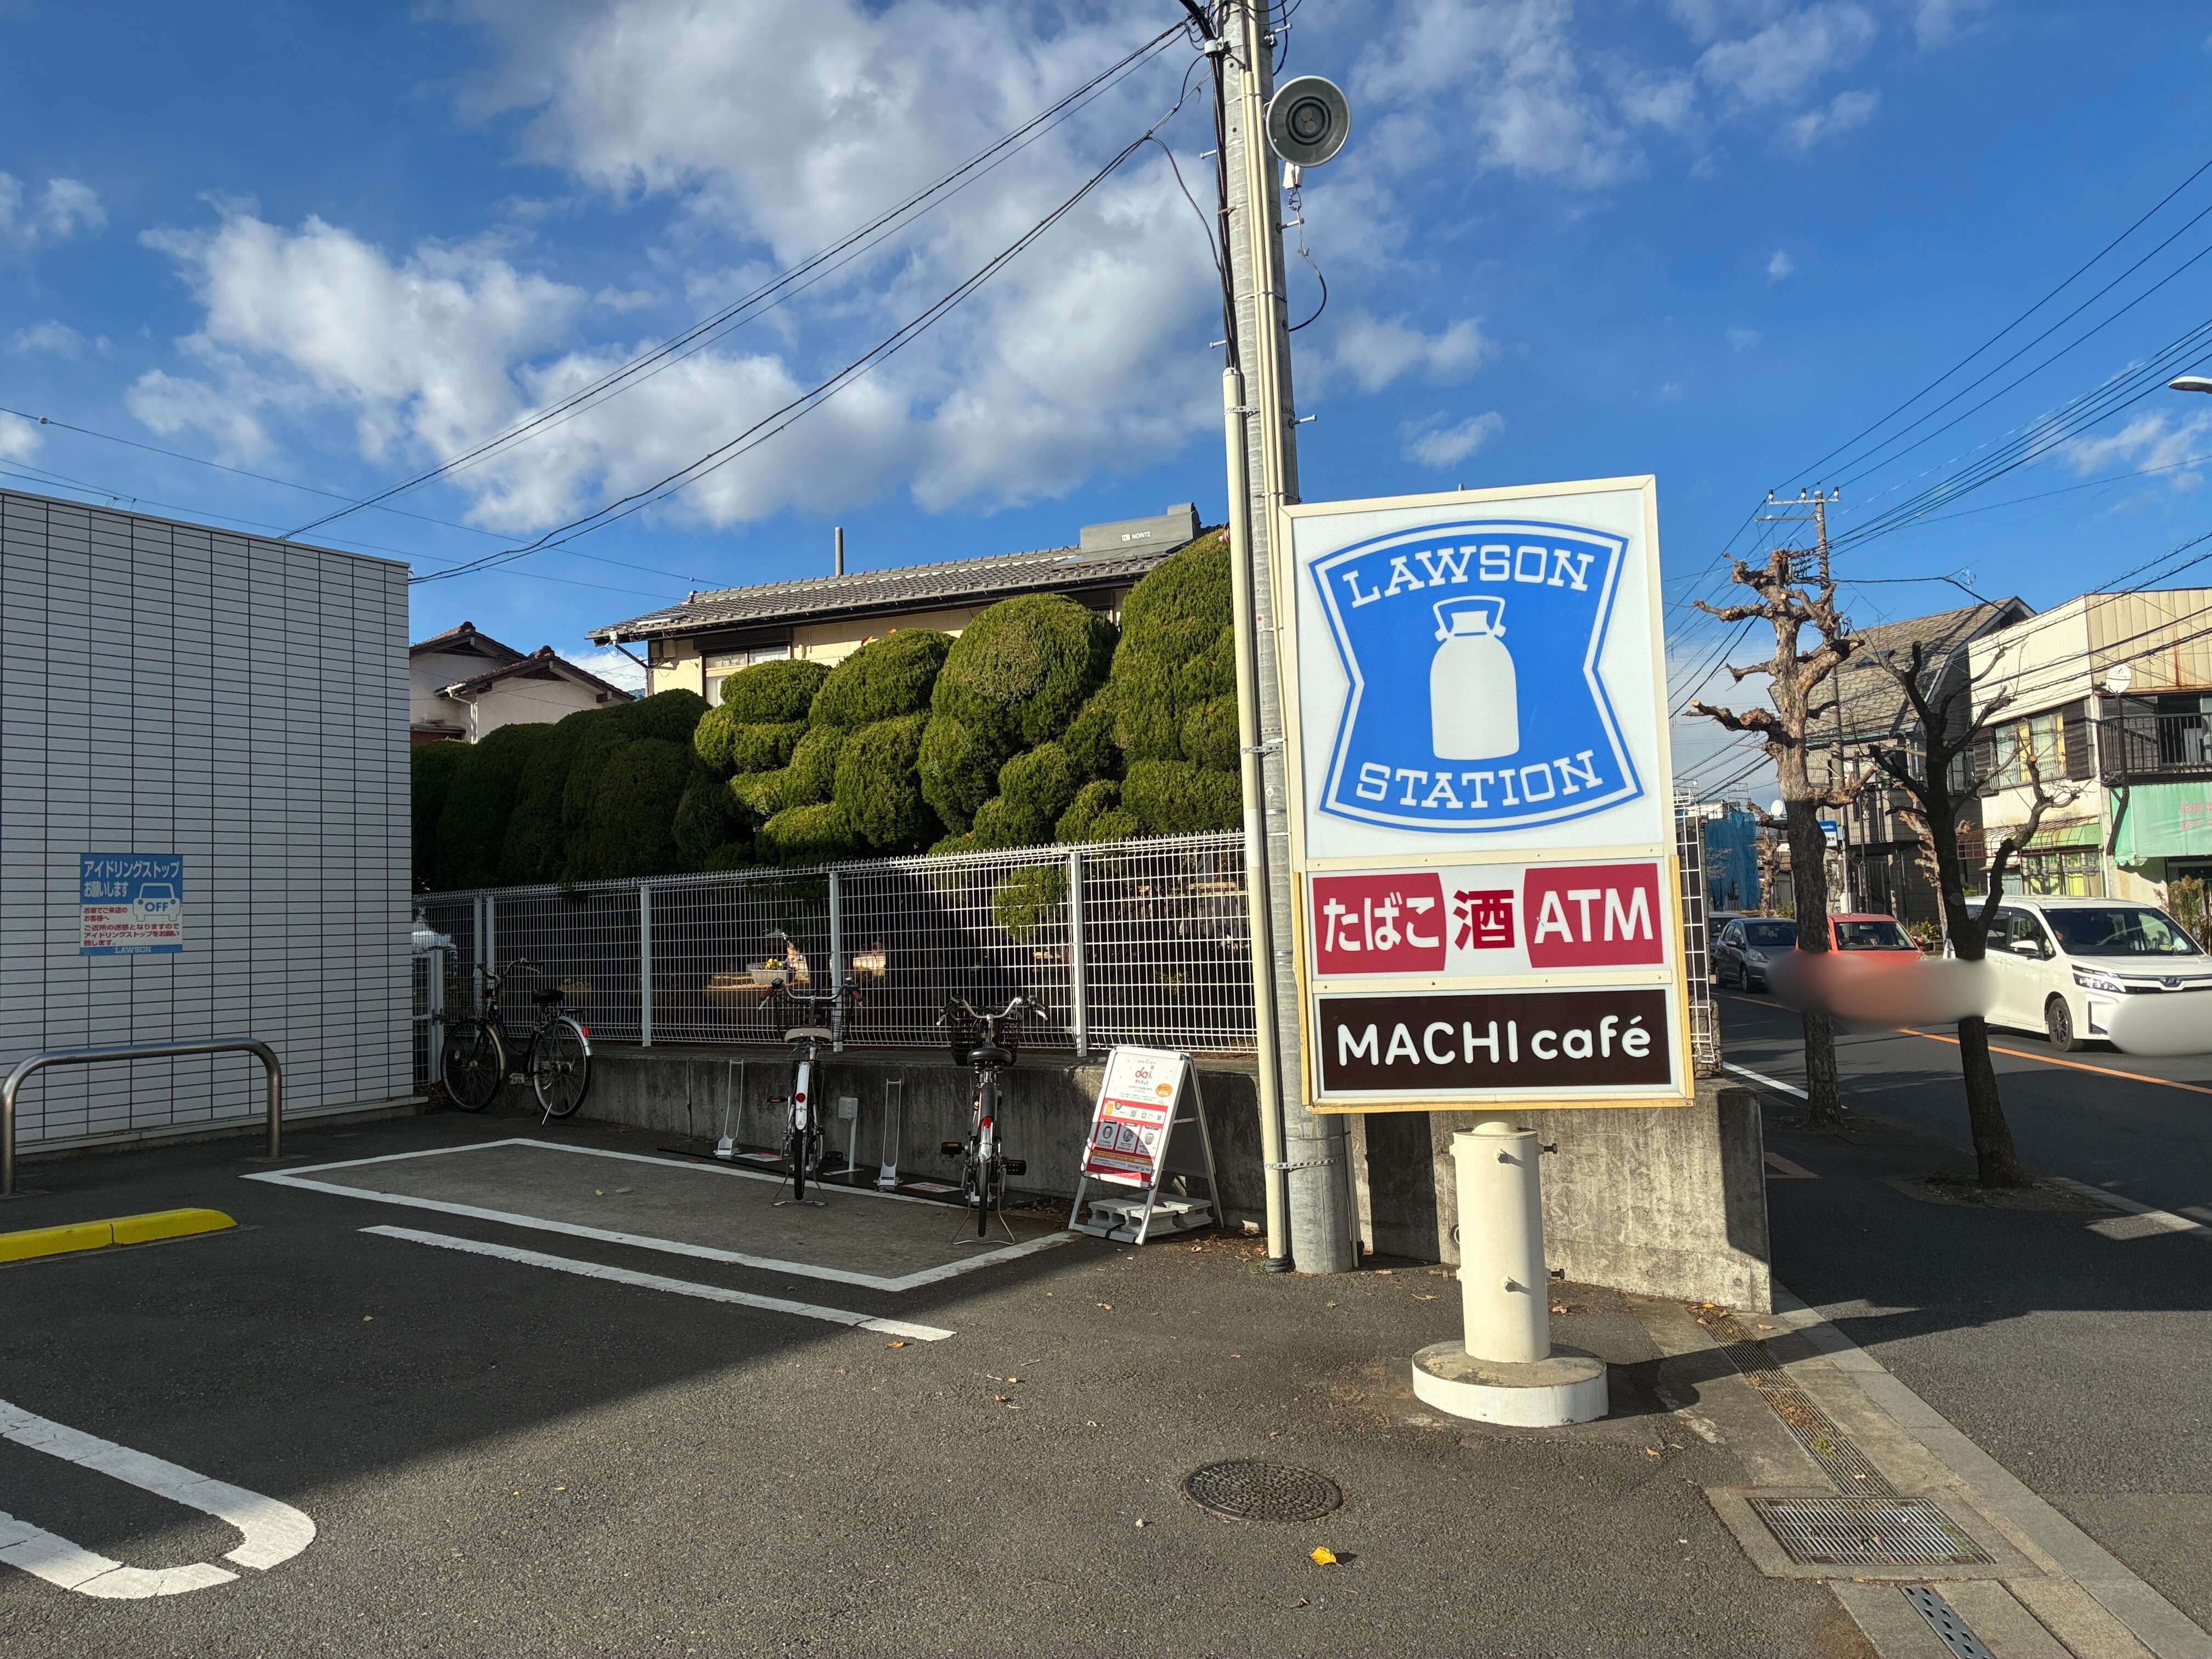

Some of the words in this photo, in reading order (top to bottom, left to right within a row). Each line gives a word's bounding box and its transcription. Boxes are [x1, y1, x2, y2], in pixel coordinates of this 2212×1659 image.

[1131, 531, 1151, 540] NORITZ
[1342, 544, 1594, 608] LAWSON
[1356, 749, 1603, 809] STATION
[83, 860, 180, 878] アイドリングストップ
[84, 881, 129, 898] お願いします
[144, 901, 168, 912] OFF
[84, 923, 180, 932] ご近所の迷惑となりますので
[1323, 891, 1440, 953] たばこ
[1453, 889, 1515, 951] 酒
[1533, 887, 1654, 944] ATM
[84, 930, 180, 939] アイドリングストップをお願い
[1336, 1019, 1518, 1066] MACHI
[1531, 1015, 1651, 1060] café
